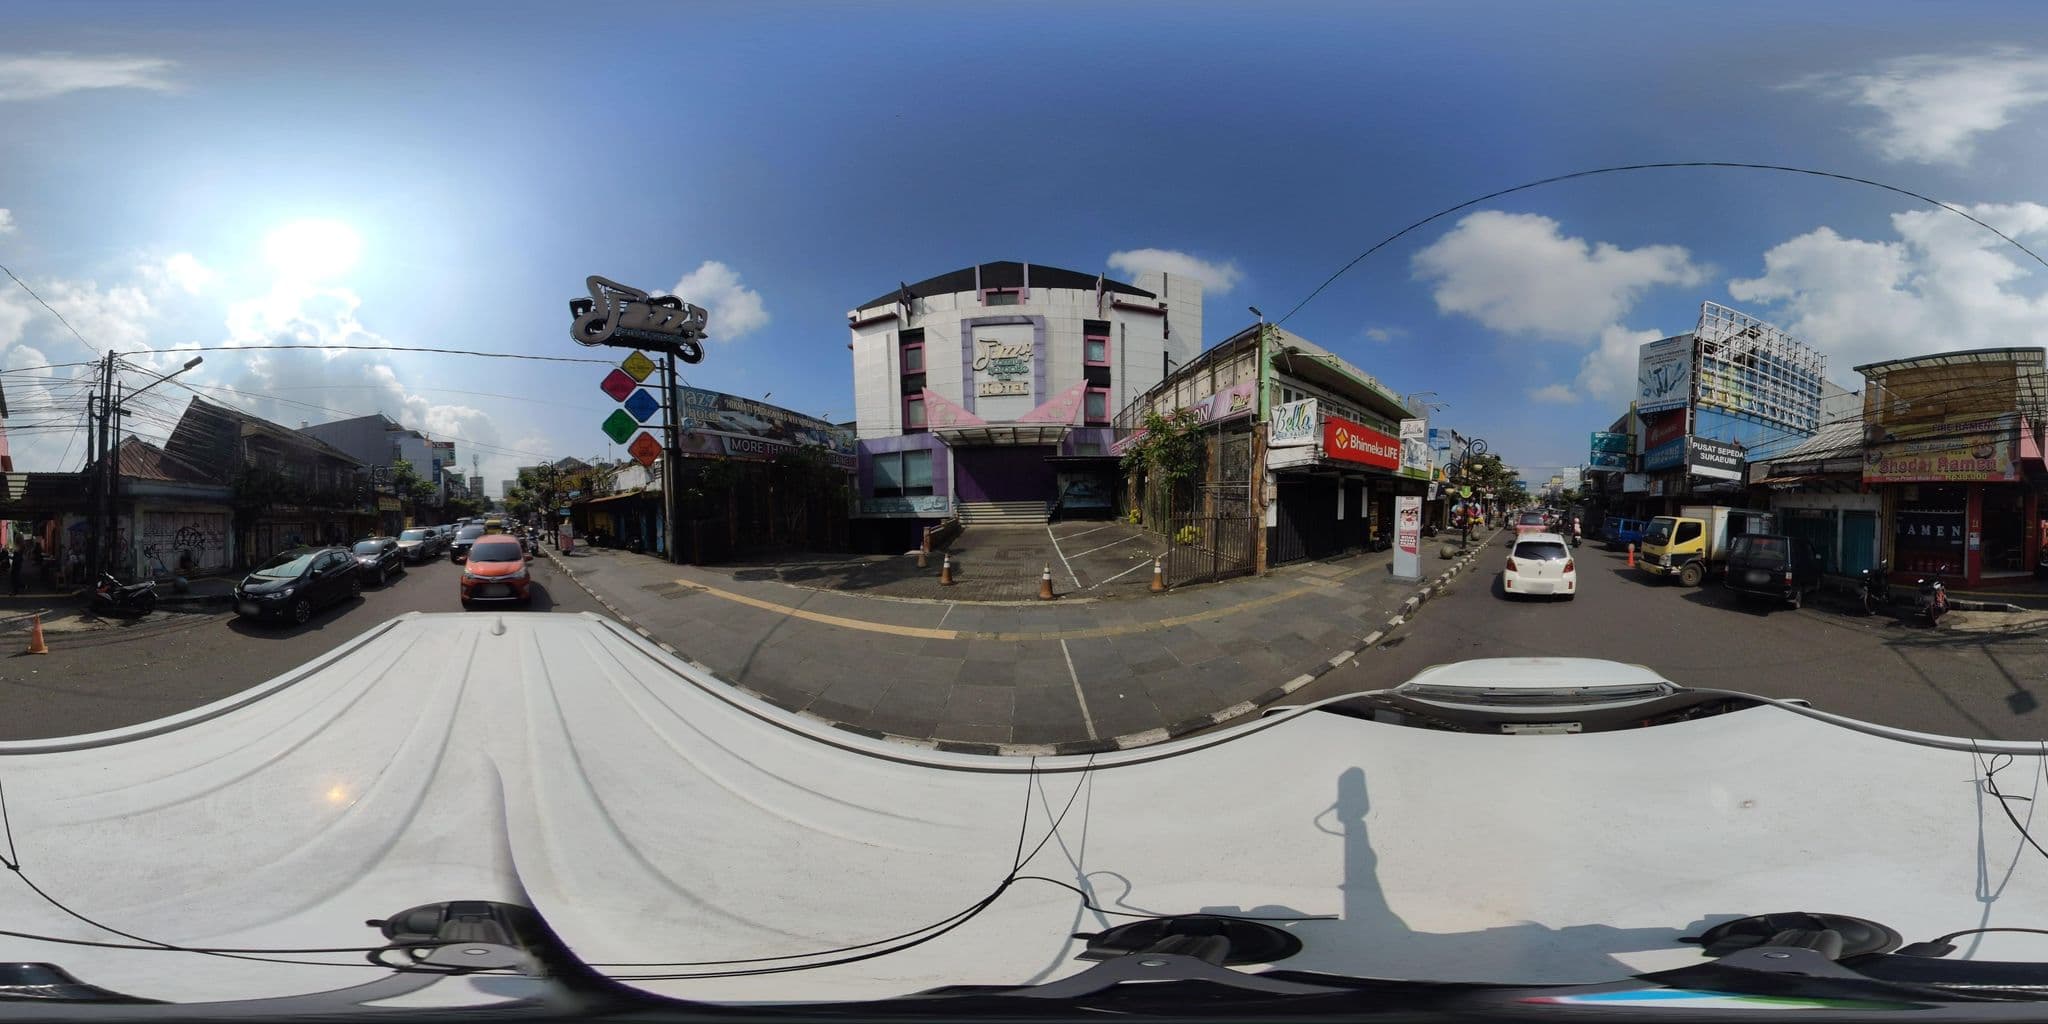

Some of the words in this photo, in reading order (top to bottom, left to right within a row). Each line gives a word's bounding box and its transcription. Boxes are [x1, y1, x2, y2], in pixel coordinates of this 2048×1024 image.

[978, 381, 1029, 397] HOTEL
[1275, 404, 1313, 433] Bella
[731, 438, 764, 453] MORE
[1350, 434, 1383, 455] Bhinneka
[1384, 446, 1398, 459] LIFE
[1692, 441, 1717, 453] PUSAT
[1717, 447, 1744, 458] SEPEDA
[1937, 456, 1997, 472] Ramen
[1896, 523, 1961, 536] AMEN
